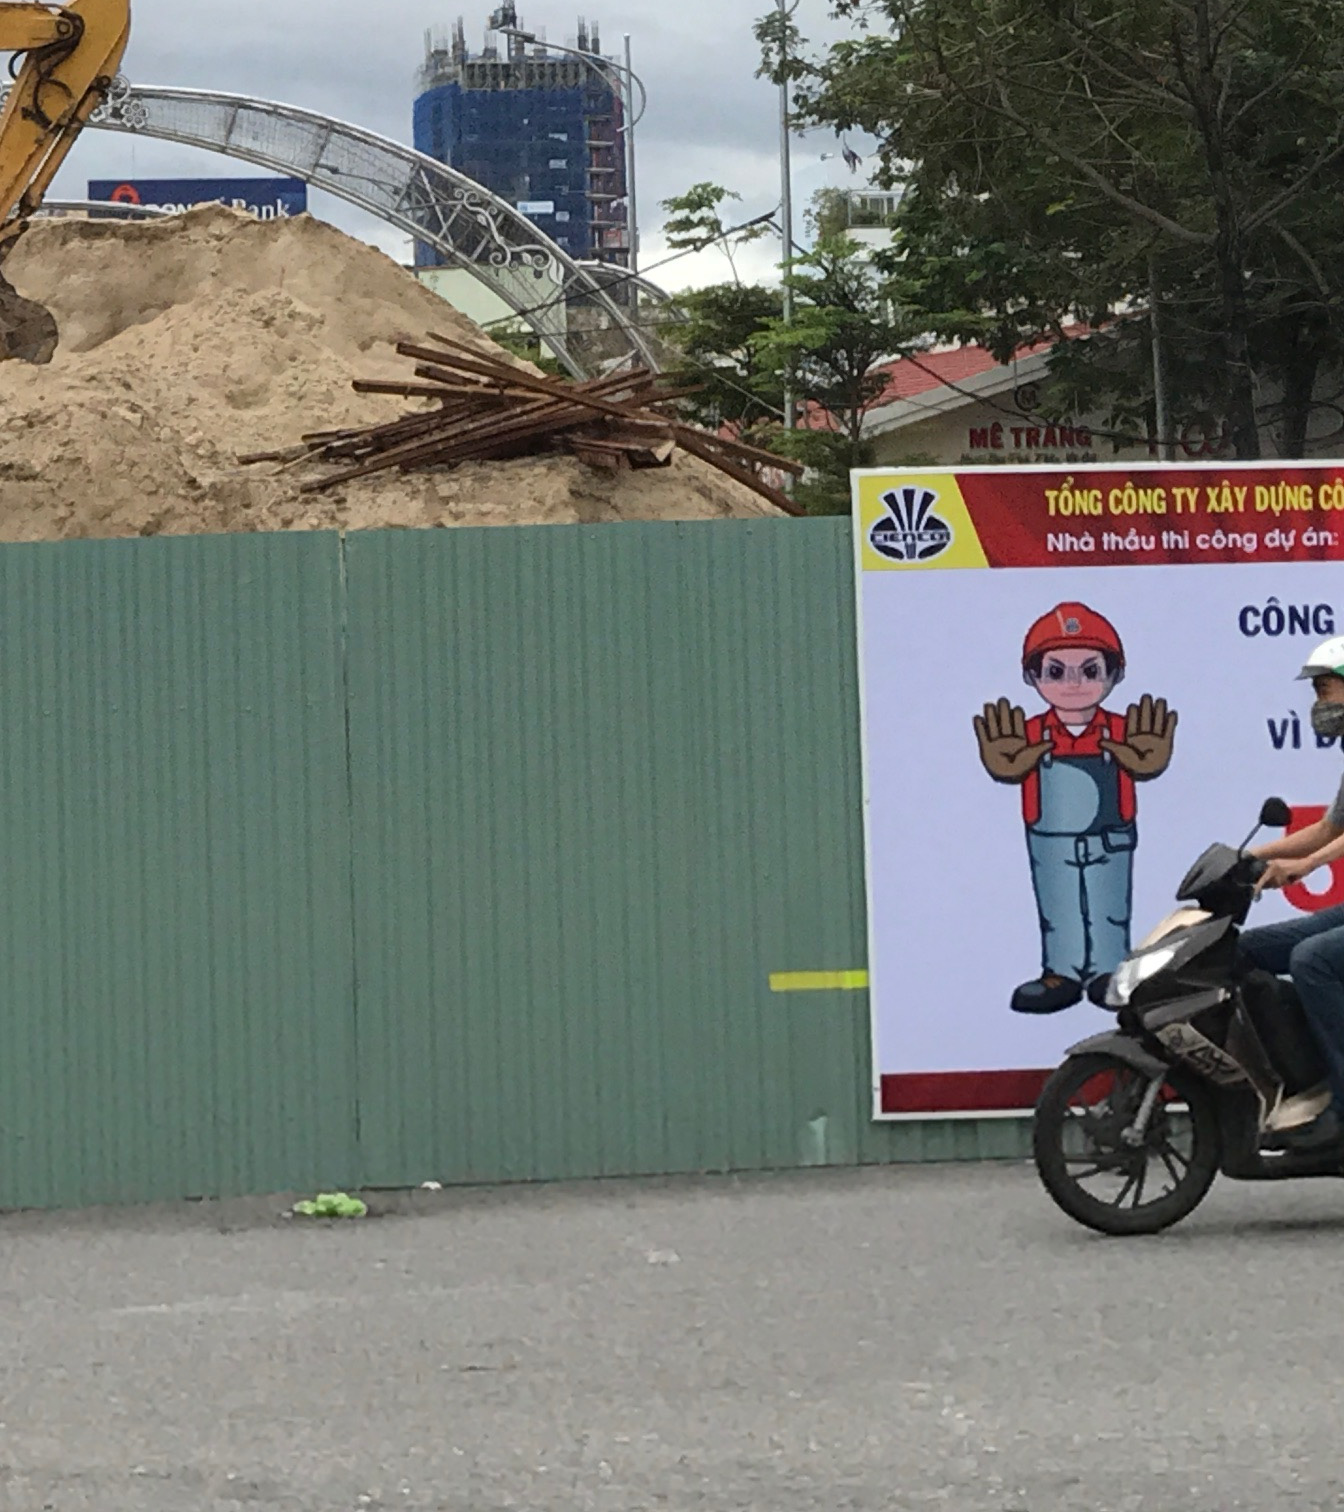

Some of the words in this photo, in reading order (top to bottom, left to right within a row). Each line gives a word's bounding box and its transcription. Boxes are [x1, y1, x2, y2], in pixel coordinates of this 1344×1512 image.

[968, 422, 1004, 450] MÊ
[1010, 424, 1093, 448] TRANG
[1044, 476, 1103, 516] TỔNG
[1108, 481, 1167, 515] CÔNG
[1171, 486, 1200, 514] TY
[1206, 479, 1248, 513] XÂY
[1254, 480, 1314, 516] DỰNG
[1047, 531, 1095, 552] Nhà
[1101, 527, 1156, 552] thầu
[1161, 530, 1190, 550] thi
[1195, 529, 1258, 553] công
[1263, 528, 1297, 552] dự
[1301, 526, 1339, 547] án:
[1238, 596, 1335, 637] CÔNG
[1267, 710, 1301, 750] VÌ
